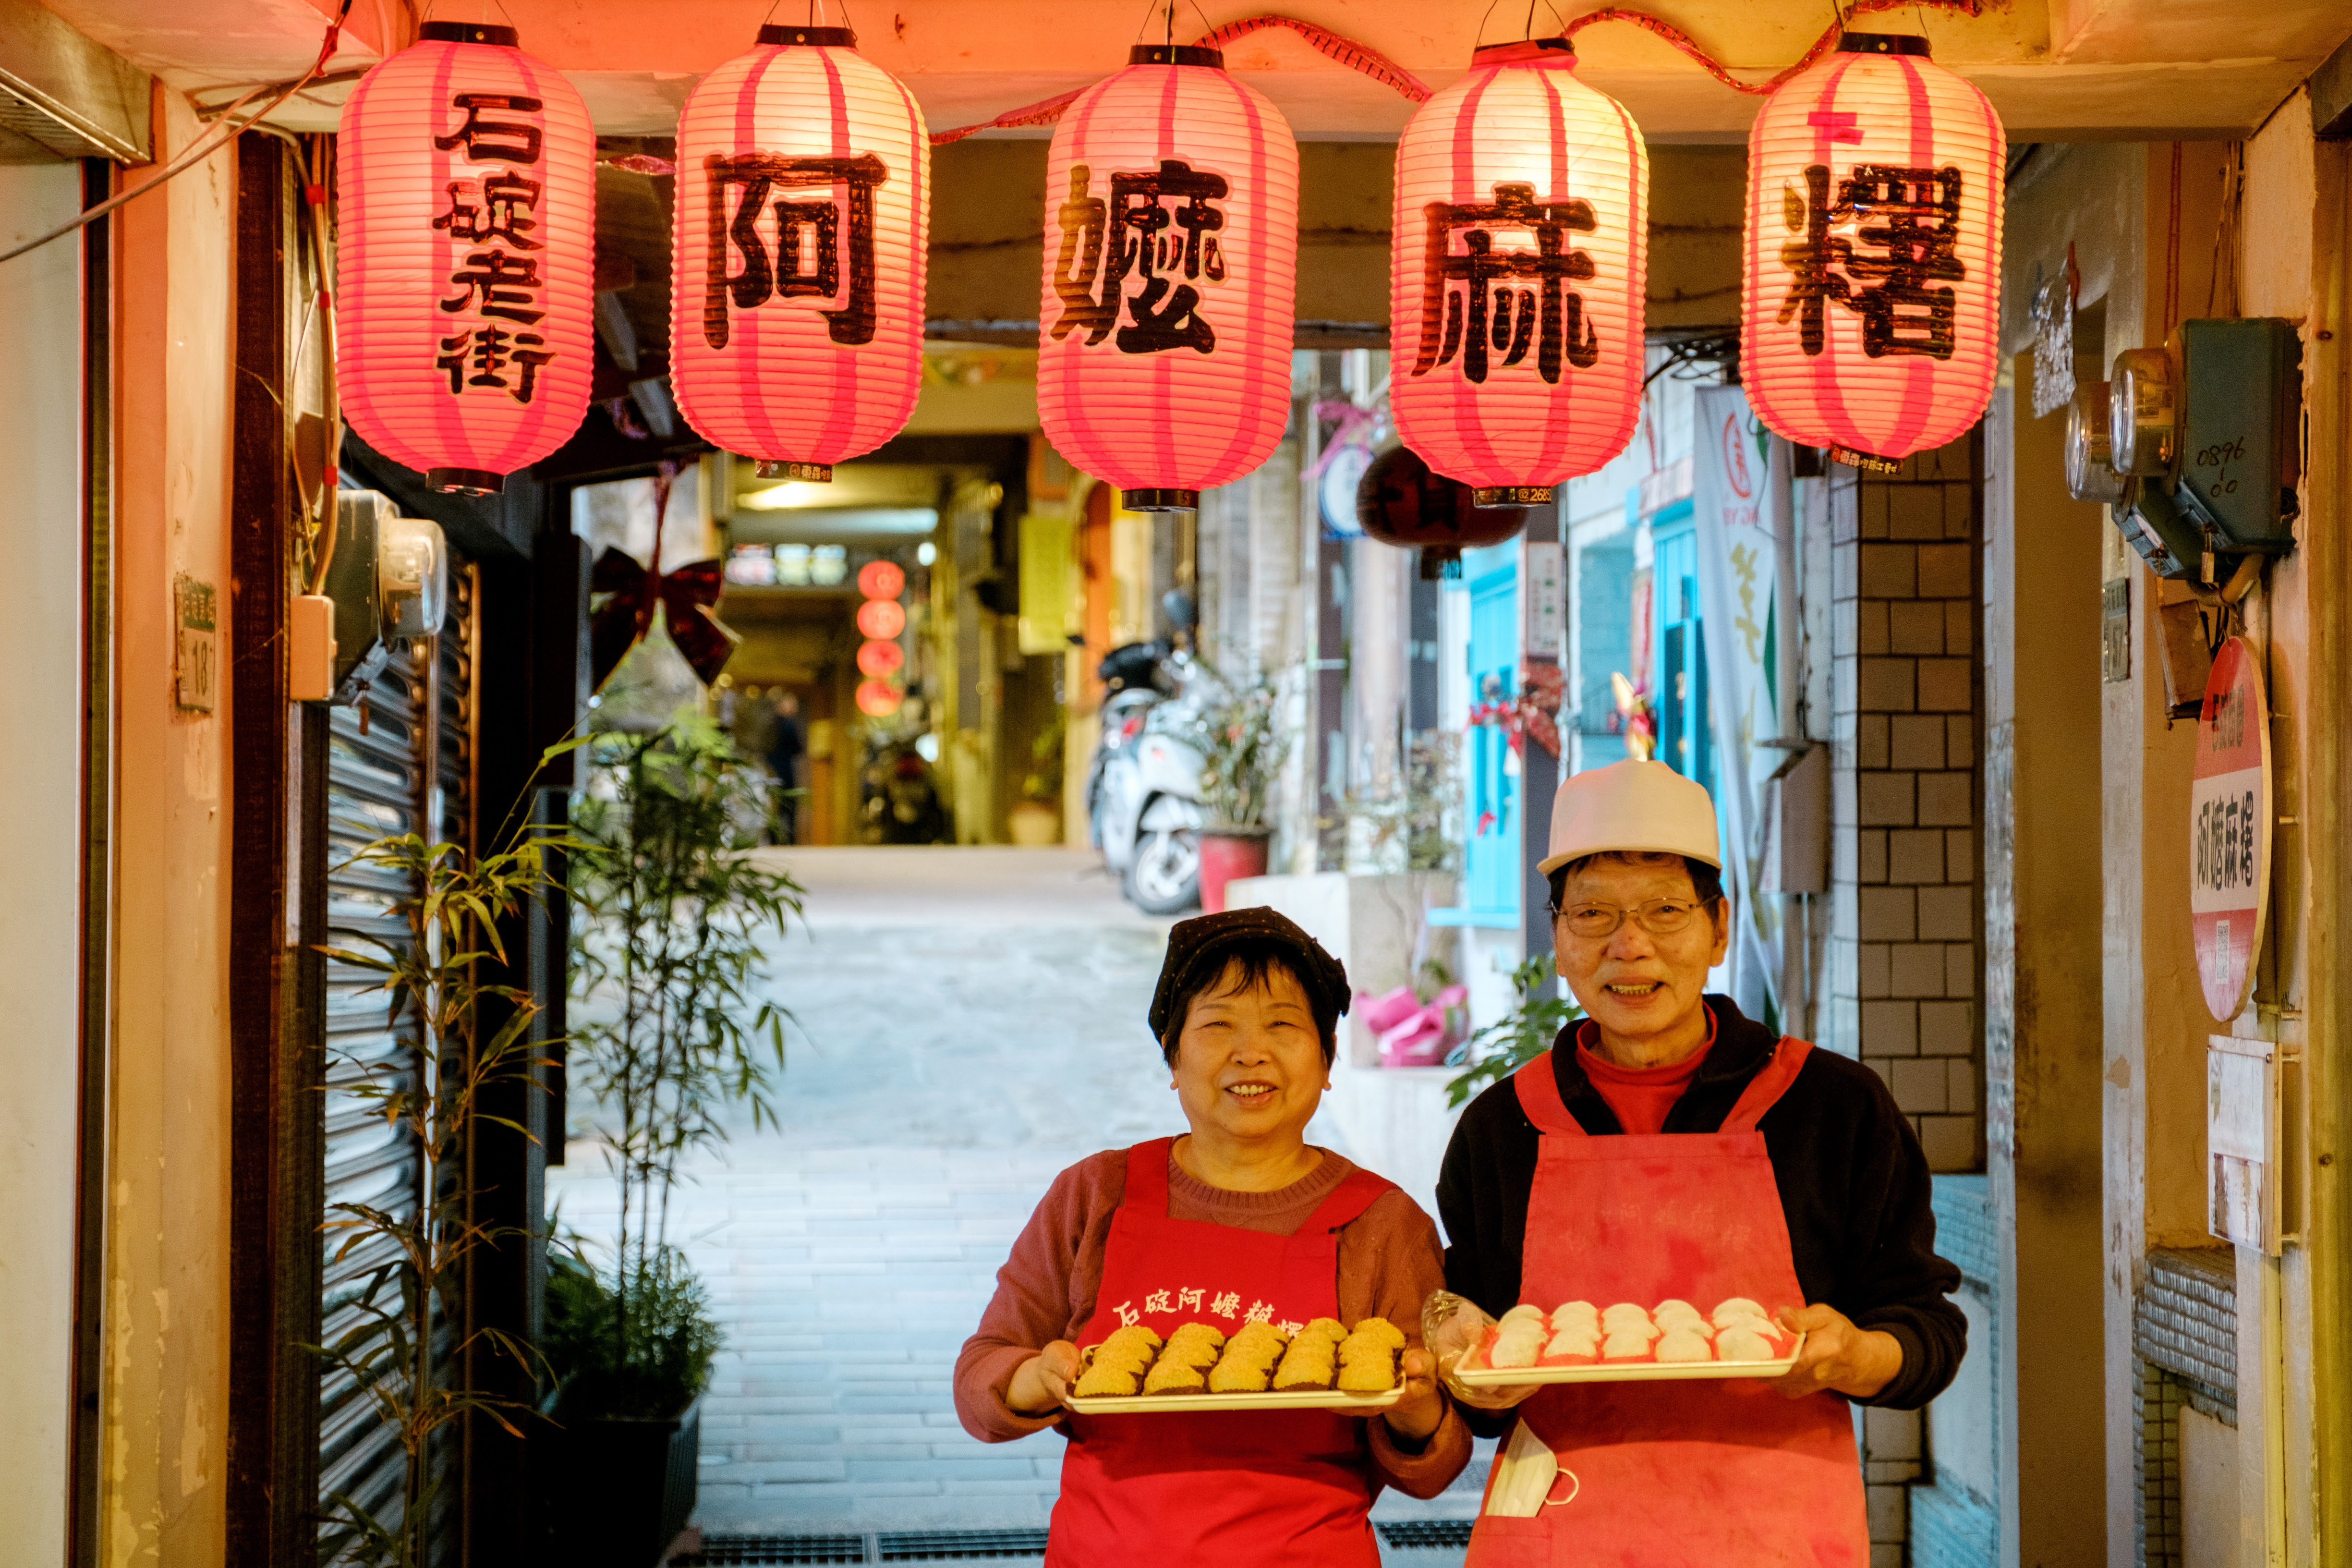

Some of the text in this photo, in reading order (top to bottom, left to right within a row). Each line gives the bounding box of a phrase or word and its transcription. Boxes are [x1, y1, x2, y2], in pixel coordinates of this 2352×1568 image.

[432, 92, 556, 404] 石碇老街
[703, 153, 886, 350] 阿
[1411, 184, 1598, 384] 麻
[2197, 436, 2245, 467] 0896
[192, 640, 207, 696] 18
